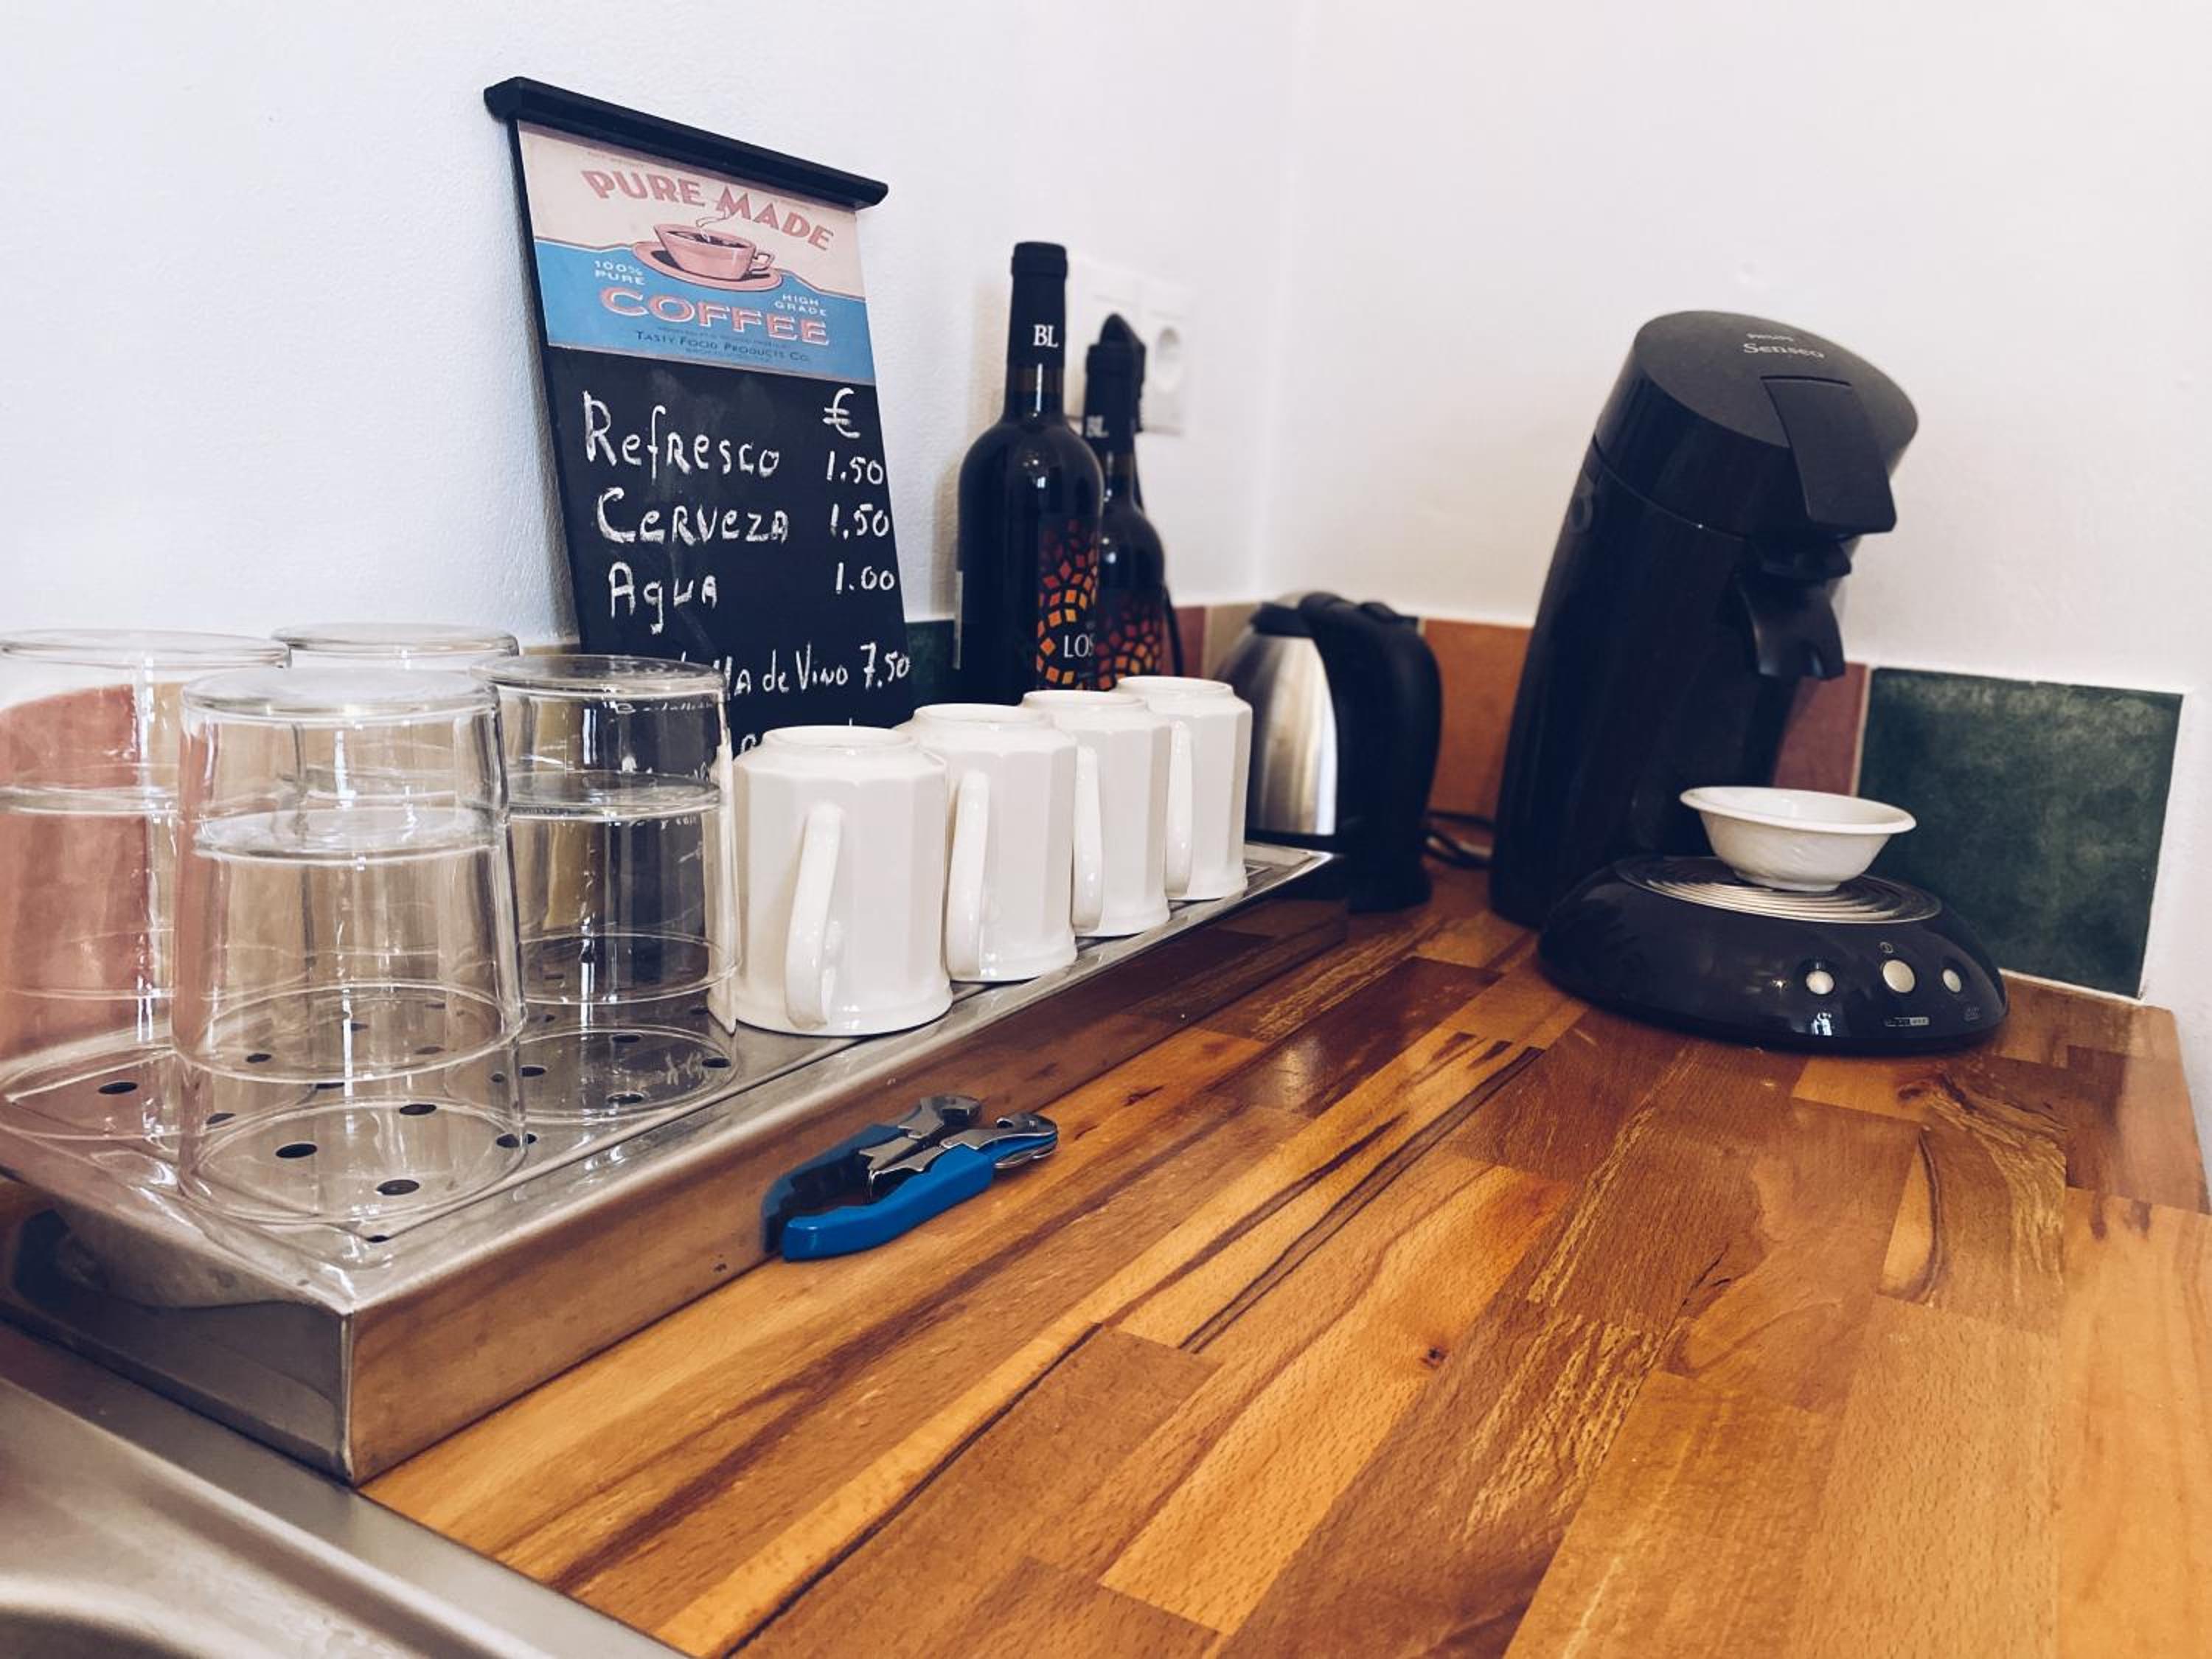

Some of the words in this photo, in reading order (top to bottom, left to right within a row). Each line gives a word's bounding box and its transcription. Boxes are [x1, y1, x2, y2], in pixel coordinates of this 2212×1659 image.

[581, 171, 705, 206] PURE
[716, 186, 834, 251] MADE
[594, 260, 644, 276] 100%
[595, 270, 645, 285] PURE
[600, 287, 830, 346] COFFEE
[774, 300, 827, 316] GRADE
[782, 293, 819, 307] HIGH
[1032, 324, 1059, 348] BL
[822, 387, 861, 439] €
[827, 451, 884, 484] 1.50
[830, 503, 890, 540] 1.50
[835, 562, 895, 595] 1.00
[762, 649, 789, 694] de
[860, 641, 911, 689] 7.50
